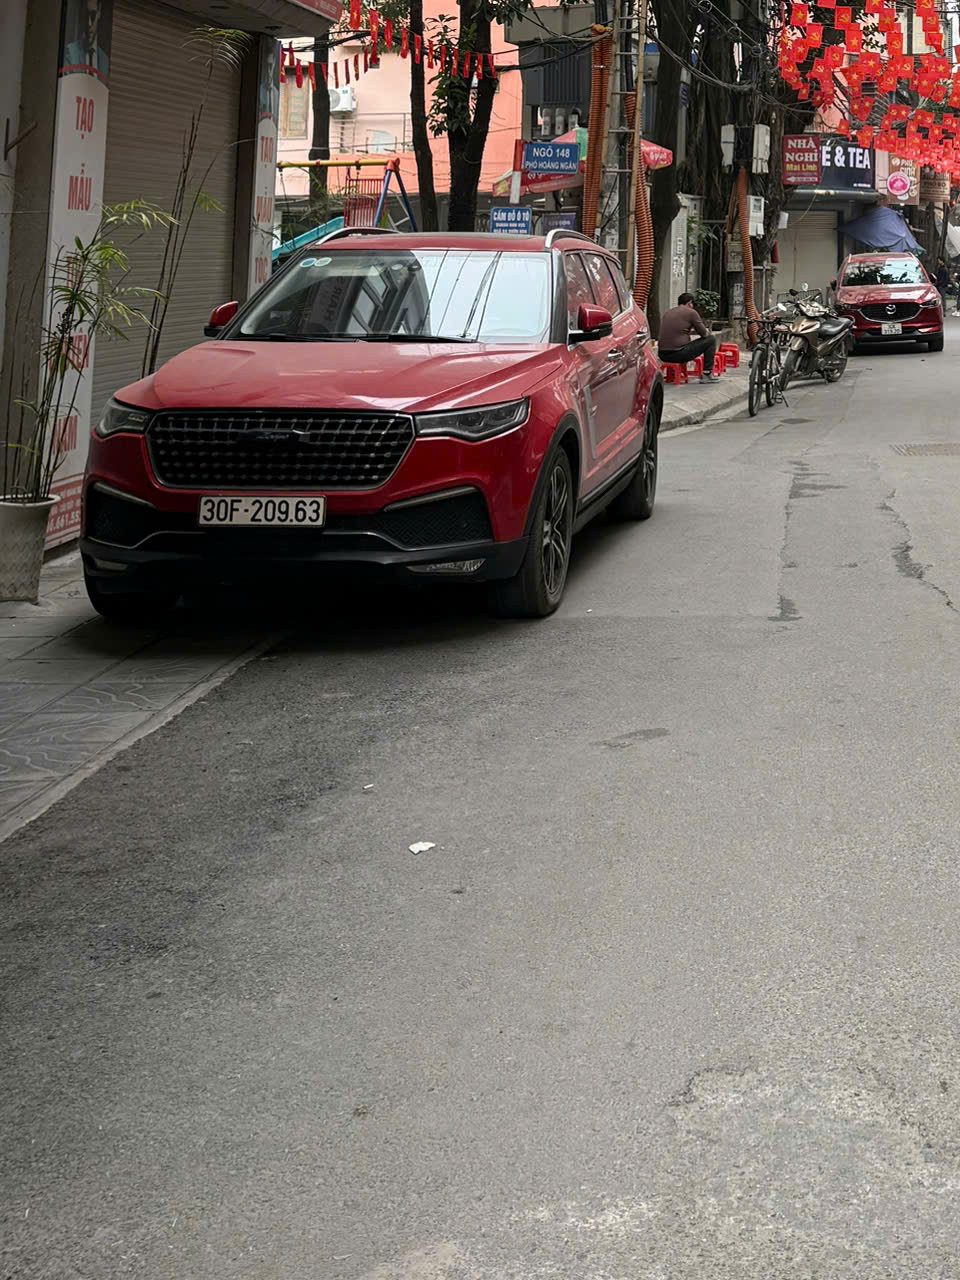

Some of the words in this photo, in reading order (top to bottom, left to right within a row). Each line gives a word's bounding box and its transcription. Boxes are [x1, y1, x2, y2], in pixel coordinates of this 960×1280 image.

[75, 95, 95, 140] TẠO
[532, 145, 554, 158] NGÕ
[556, 148, 570, 158] 148
[788, 137, 816, 149] NHÀ
[785, 149, 818, 162] NGHỈ
[834, 145, 846, 168] &
[847, 147, 871, 169] TEA
[68, 163, 93, 212] MẪU
[202, 498, 321, 523] 30F-209.63
